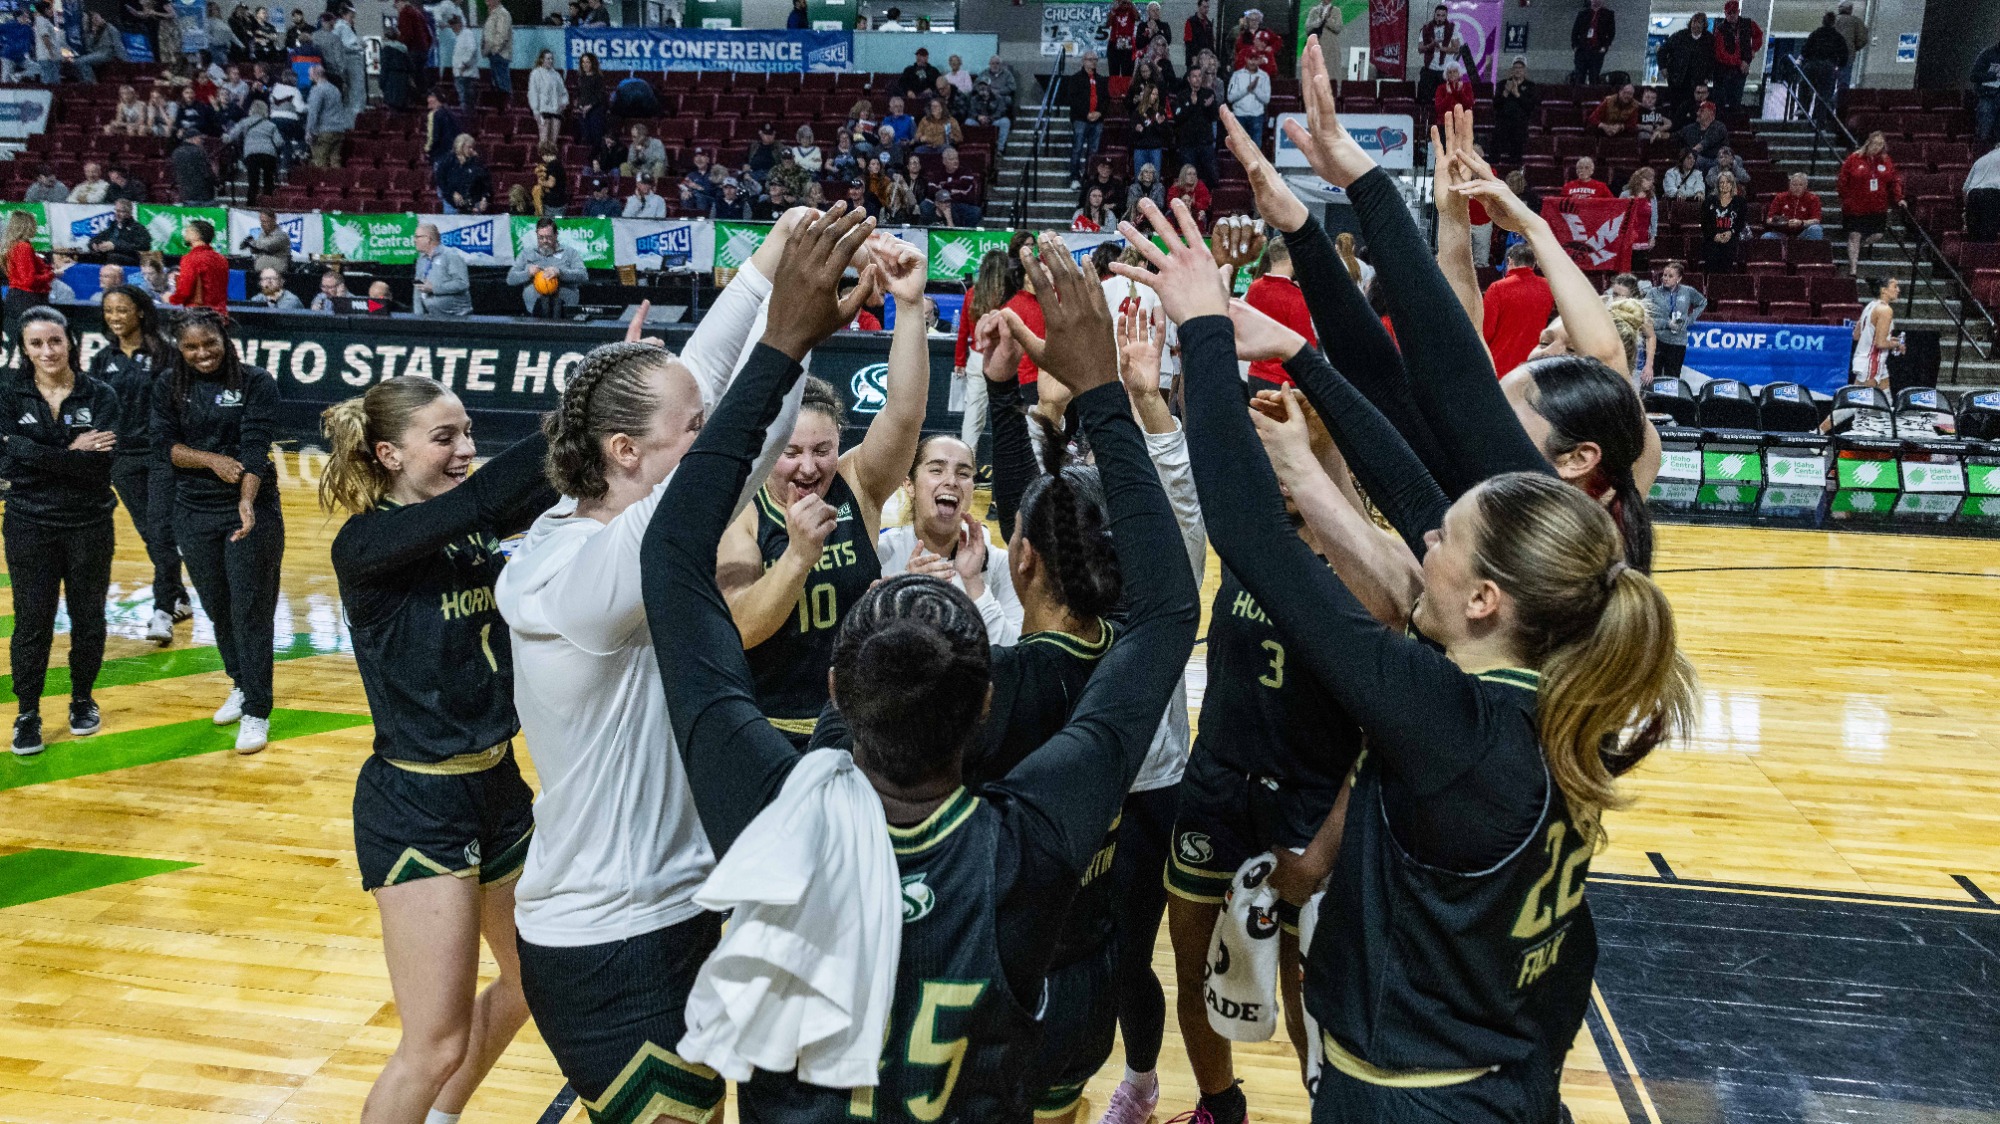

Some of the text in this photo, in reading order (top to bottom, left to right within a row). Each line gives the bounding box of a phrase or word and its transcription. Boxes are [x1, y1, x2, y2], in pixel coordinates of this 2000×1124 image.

[571, 38, 802, 60] BIG SKY CONFERENCE
[368, 222, 402, 235] Idaho
[369, 235, 416, 248] Central
[341, 343, 500, 392] STATE
[1671, 461, 1698, 469] Central
[441, 586, 498, 620] HORN
[798, 583, 837, 633] 10
[480, 623, 498, 673] 1
[1258, 639, 1285, 689] 3
